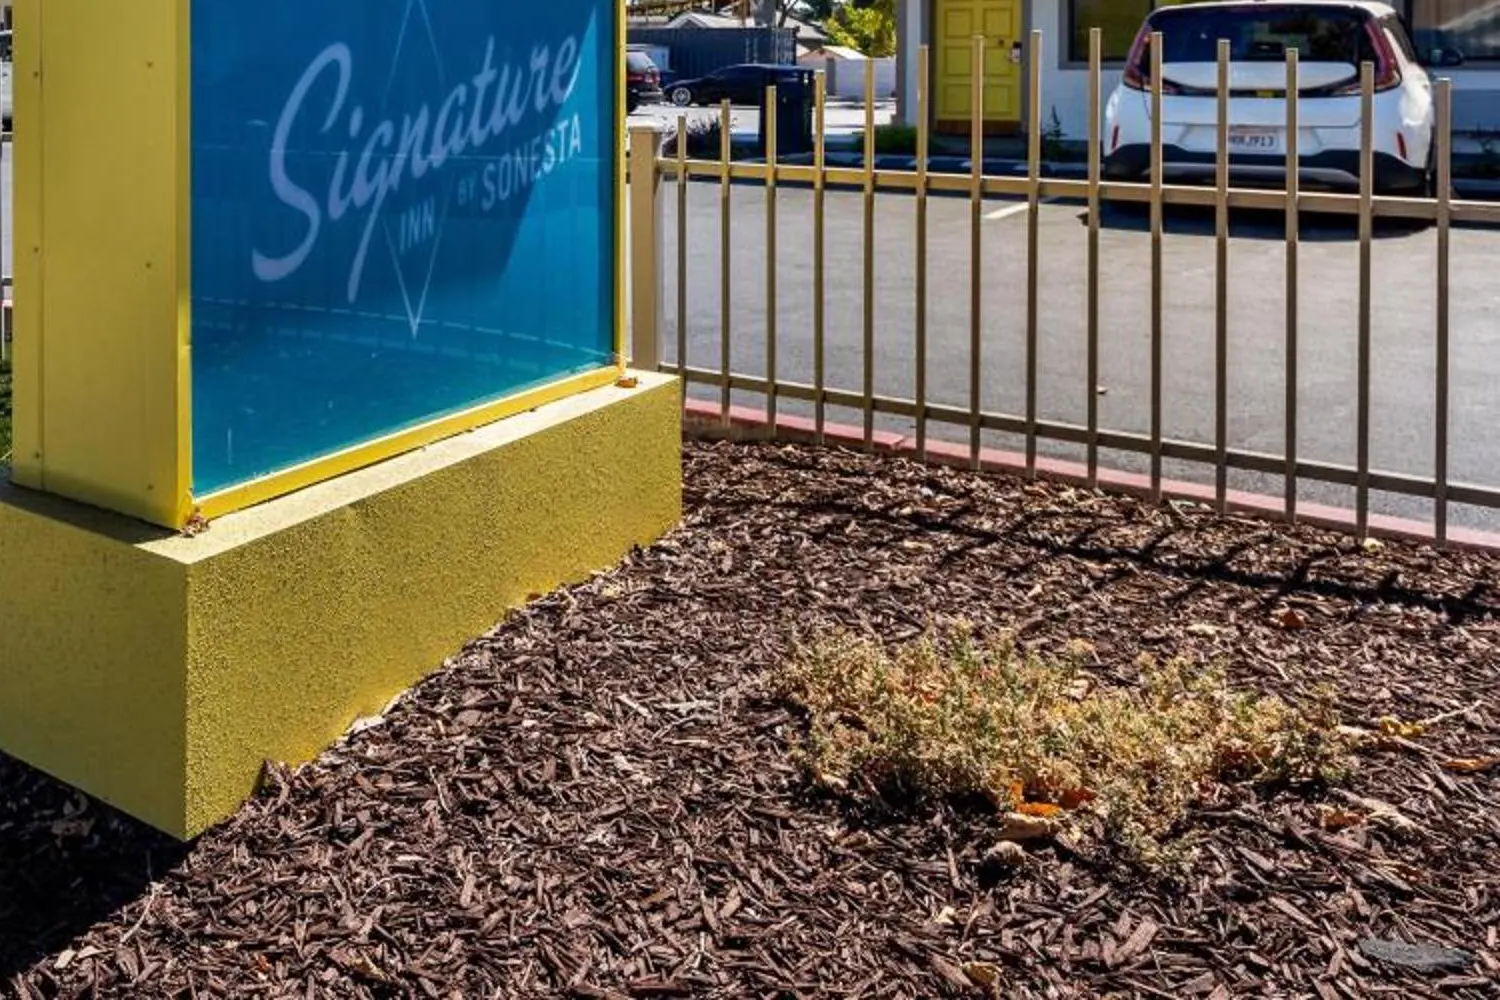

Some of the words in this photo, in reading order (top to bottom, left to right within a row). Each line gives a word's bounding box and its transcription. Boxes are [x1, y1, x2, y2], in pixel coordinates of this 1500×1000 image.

[252, 34, 582, 304] Signature
[457, 179, 478, 206] BY
[481, 113, 582, 211] SONESTA
[400, 198, 435, 256] INN
